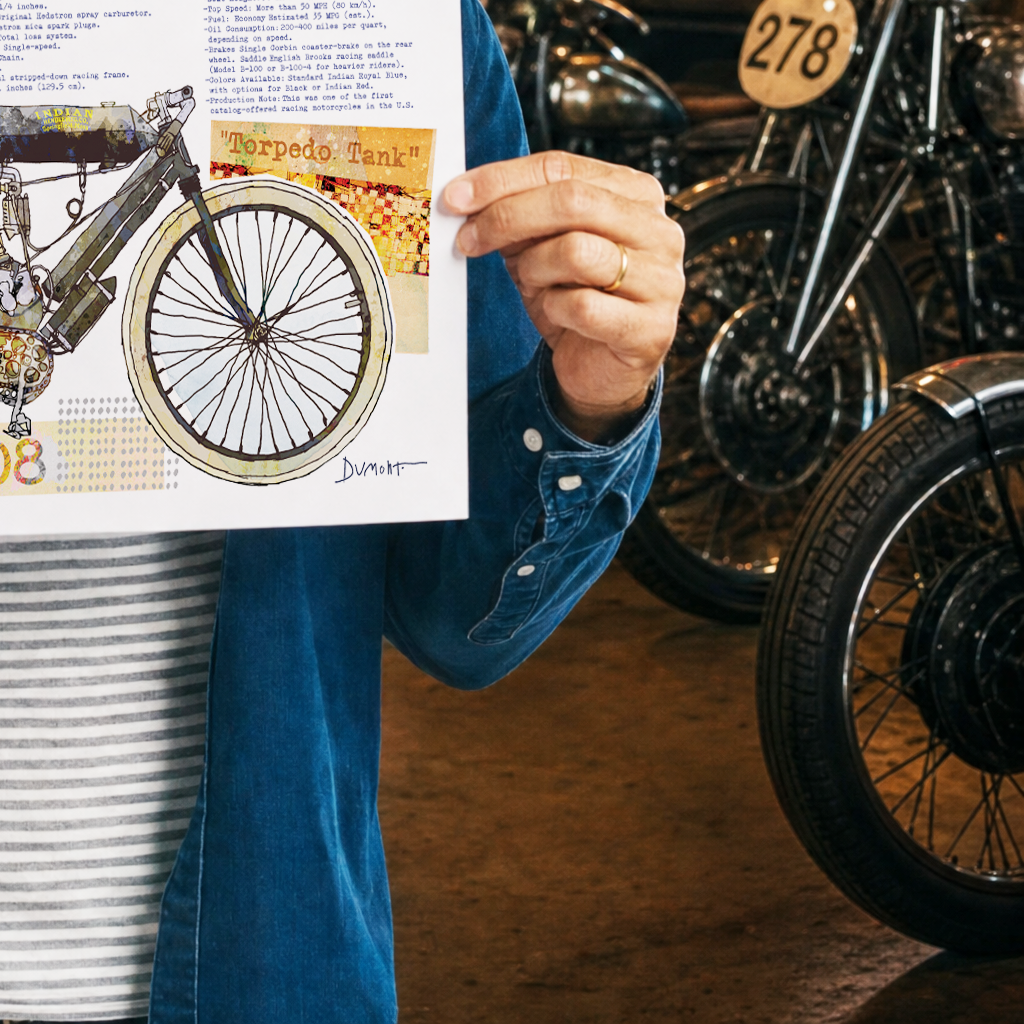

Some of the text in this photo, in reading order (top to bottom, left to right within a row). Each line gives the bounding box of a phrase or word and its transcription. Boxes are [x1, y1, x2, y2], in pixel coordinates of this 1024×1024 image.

[203, 5, 222, 14] -Top
[225, 5, 251, 13] Speed:
[256, 4, 274, 12] More
[349, 0, 376, 9] km/h).
[76, 12, 99, 20] spray
[103, 10, 152, 18] carburetor.
[204, 15, 229, 23] -Fuel:
[344, 10, 374, 20] (est.).
[47, 22, 70, 31] spark
[74, 22, 100, 30] plugs.
[204, 25, 221, 33] -Oil
[360, 22, 386, 30] quart,
[46, 33, 77, 41] system.
[208, 34, 292, 44] depending speed.
[4, 42, 61, 52] Single-speed.
[239, 45, 266, 53] Single
[301, 43, 360, 51] coaster-brake
[745, 13, 839, 80] 278
[305, 53, 332, 61] Brooks
[367, 51, 394, 59] saddle
[209, 65, 236, 74] (Model
[333, 62, 365, 70] heavier
[369, 60, 404, 69] riders).
[10, 73, 68, 82] stripped-down
[72, 72, 99, 80] racing
[104, 71, 130, 79] frame.
[205, 76, 236, 84] -Colors
[240, 75, 284, 83] Available:
[288, 73, 324, 82] Standard
[358, 72, 381, 80] Royal
[6, 84, 33, 92] inches
[210, 86, 228, 94] with
[232, 86, 263, 94] options
[285, 84, 307, 92] Black
[326, 83, 352, 91] Indian
[356, 82, 373, 90] Red.
[206, 96, 255, 104] -Production
[371, 92, 393, 100] first
[210, 105, 277, 114] catalog-offered
[312, 103, 361, 111] motorcycles
[396, 101, 414, 109] U.S.
[34, 107, 94, 120] INDIAN
[220, 130, 420, 168] "Torpedo Tank"
